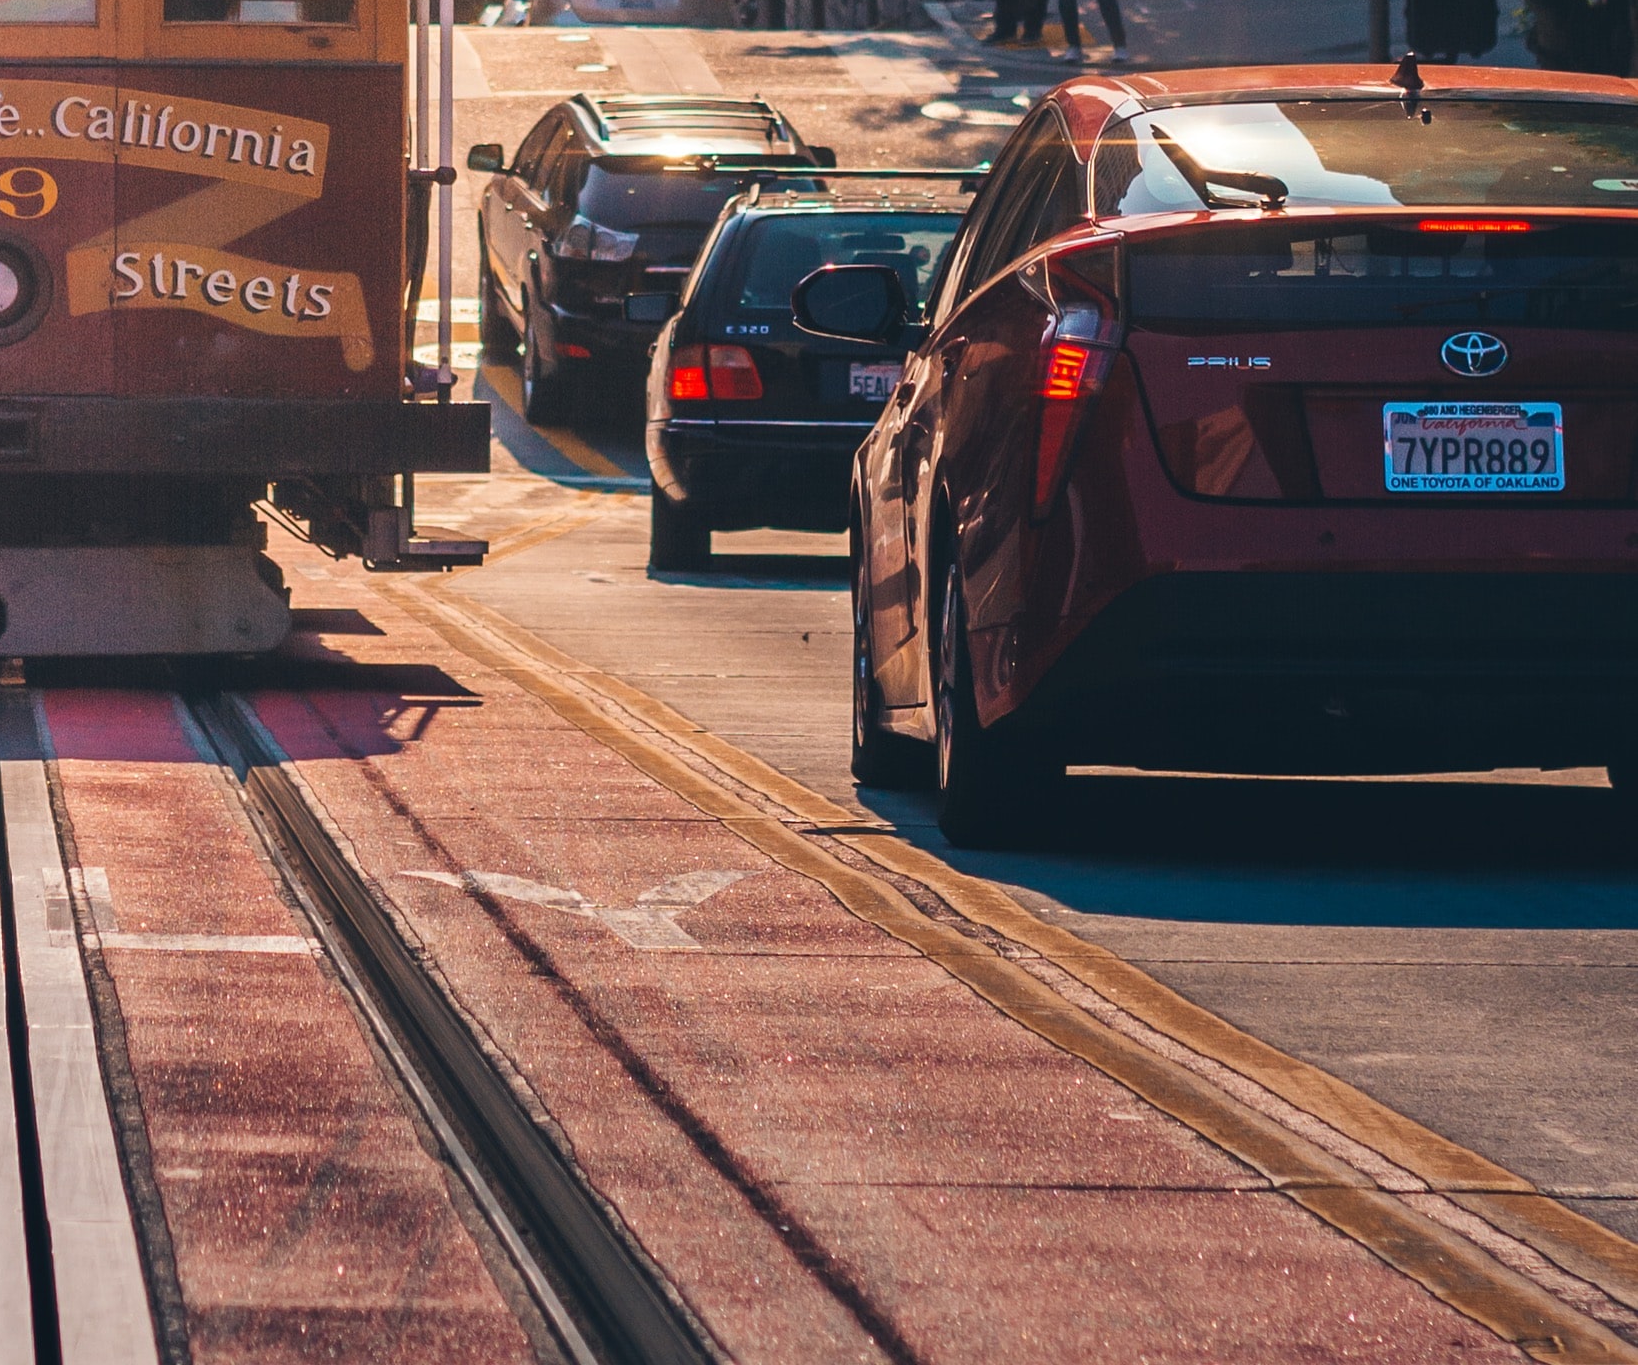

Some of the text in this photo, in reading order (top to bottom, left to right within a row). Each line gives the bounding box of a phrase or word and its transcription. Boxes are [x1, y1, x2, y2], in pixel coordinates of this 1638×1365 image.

[54, 95, 317, 176] California
[114, 251, 336, 318] Streets
[725, 325, 770, 335] E 320
[1186, 356, 1272, 370] PRIUS
[1424, 405, 1522, 416] 880 AND HEGENBERGER
[1421, 417, 1528, 436] California
[1396, 437, 1551, 474] 7YPR889
[1391, 477, 1560, 489] ONE TOYOTA OF OAKLAND
